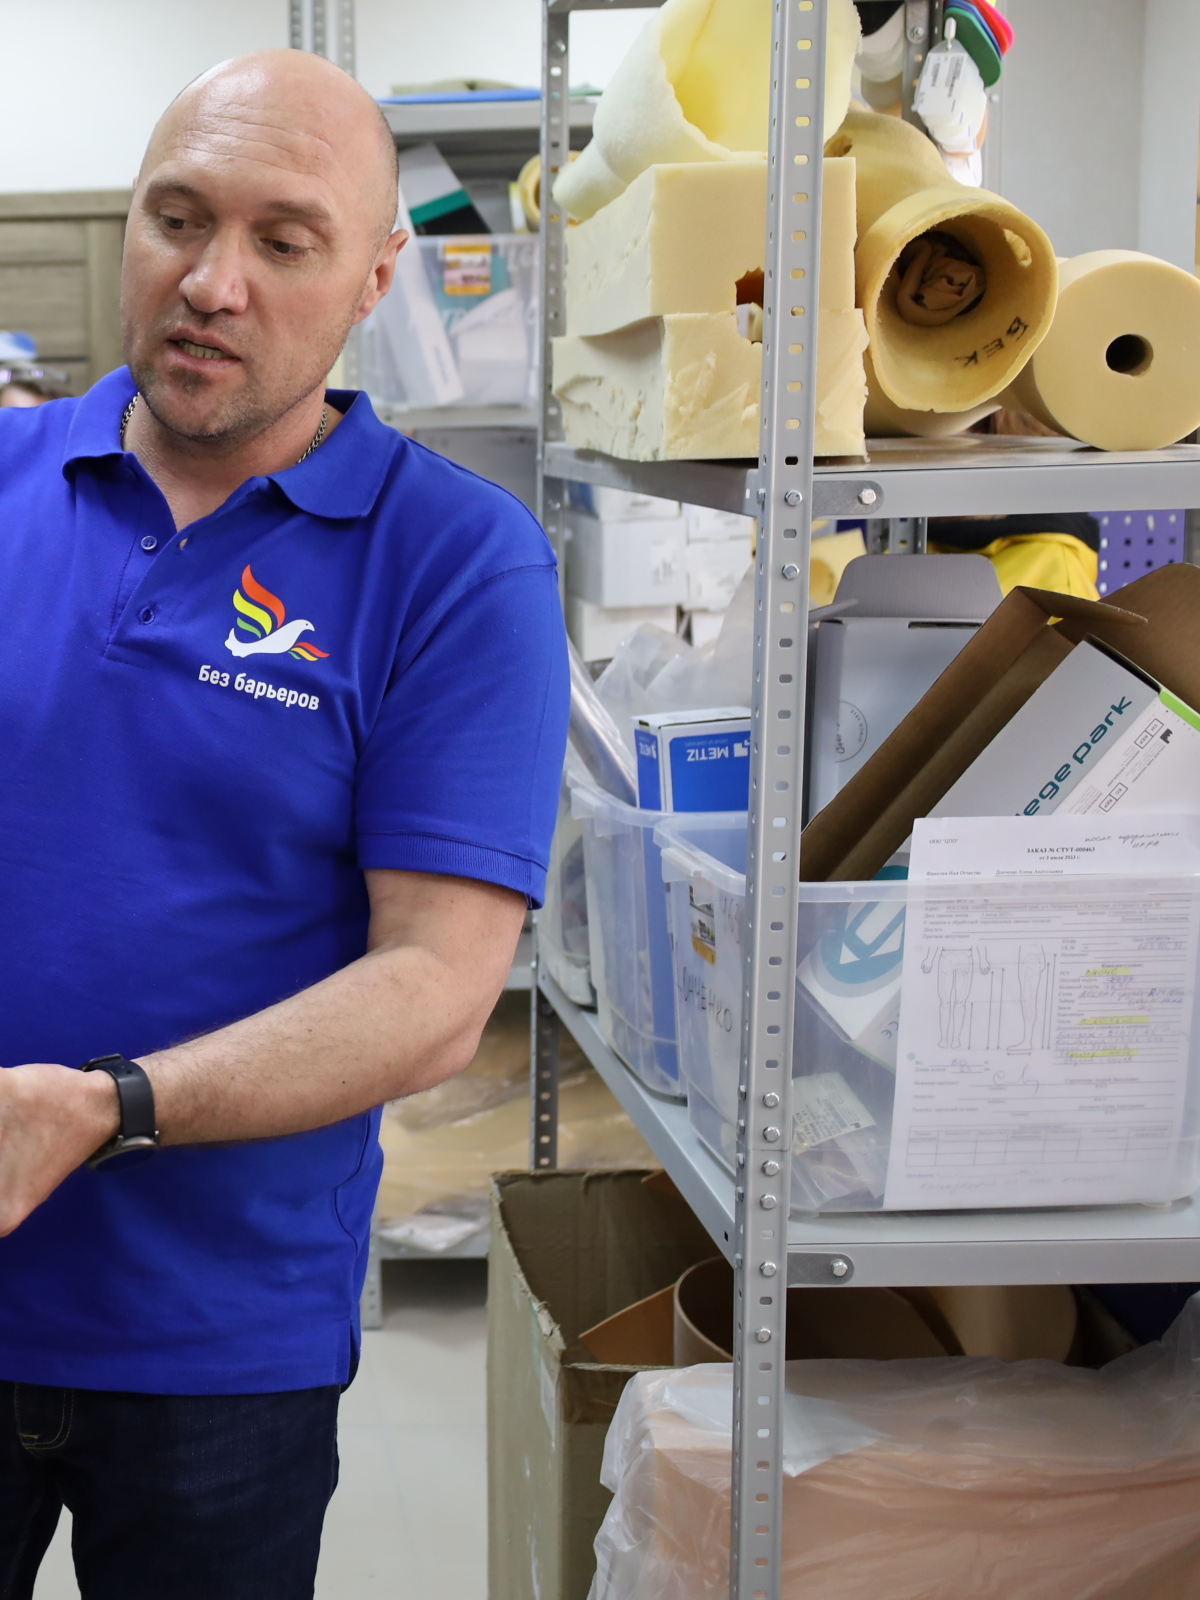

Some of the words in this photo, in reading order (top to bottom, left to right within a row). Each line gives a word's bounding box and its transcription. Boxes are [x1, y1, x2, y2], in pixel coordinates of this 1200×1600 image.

[198, 664, 231, 688] Без
[233, 672, 320, 711] барьеров
[687, 746, 729, 762] METIZ
[1014, 763, 1072, 816] ege
[1072, 696, 1132, 764] park
